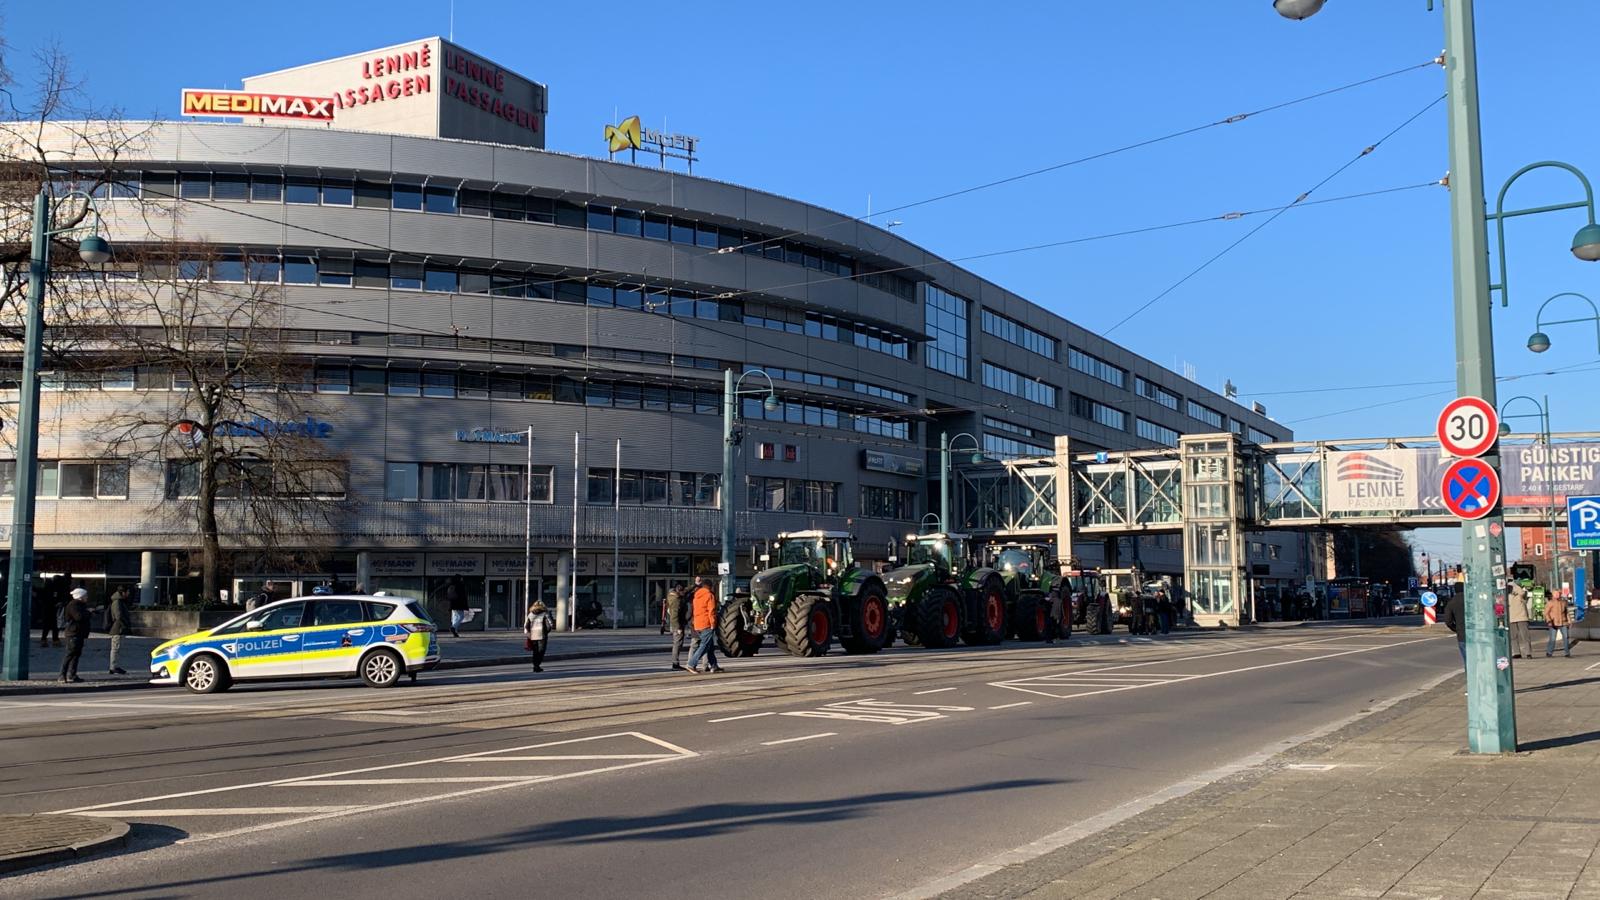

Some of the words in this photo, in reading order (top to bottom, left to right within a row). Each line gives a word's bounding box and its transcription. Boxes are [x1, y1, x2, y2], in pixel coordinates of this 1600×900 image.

[362, 44, 431, 79] LENNÉ
[447, 50, 505, 93] LENNÉ
[333, 74, 431, 109] ASSAGEN
[446, 76, 539, 132] PASSAGEN
[185, 93, 330, 117] MEDIMAX
[1450, 414, 1484, 441] 30
[1521, 465, 1594, 482] PARKEN
[1348, 498, 1405, 508] PASSAGEN
[1580, 507, 1598, 530] P
[237, 640, 283, 652] POLIZEI
